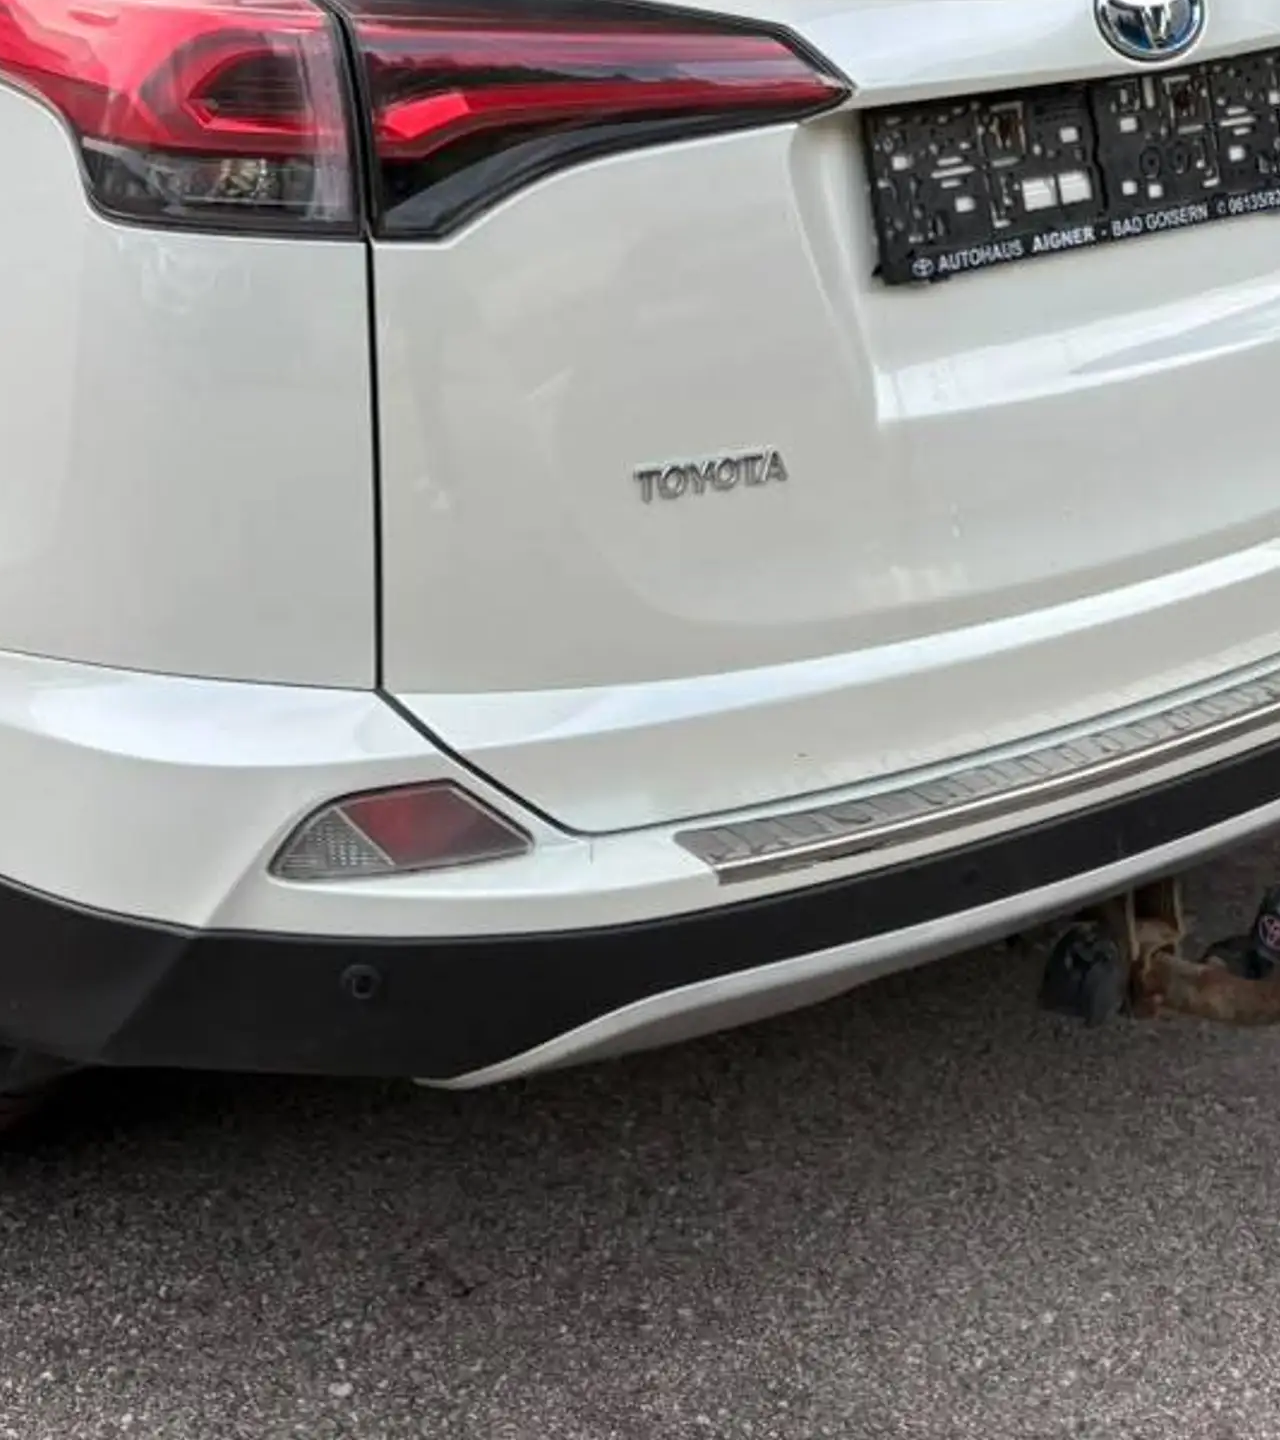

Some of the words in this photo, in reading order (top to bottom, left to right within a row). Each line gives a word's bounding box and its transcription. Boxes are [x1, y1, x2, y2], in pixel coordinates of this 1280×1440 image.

[938, 238, 1024, 274] AUTOHAUS
[1032, 224, 1096, 253] AIGNER
[1111, 218, 1143, 237] BAD
[1146, 203, 1209, 230] GOISERN
[632, 449, 789, 505] TOYOTA
